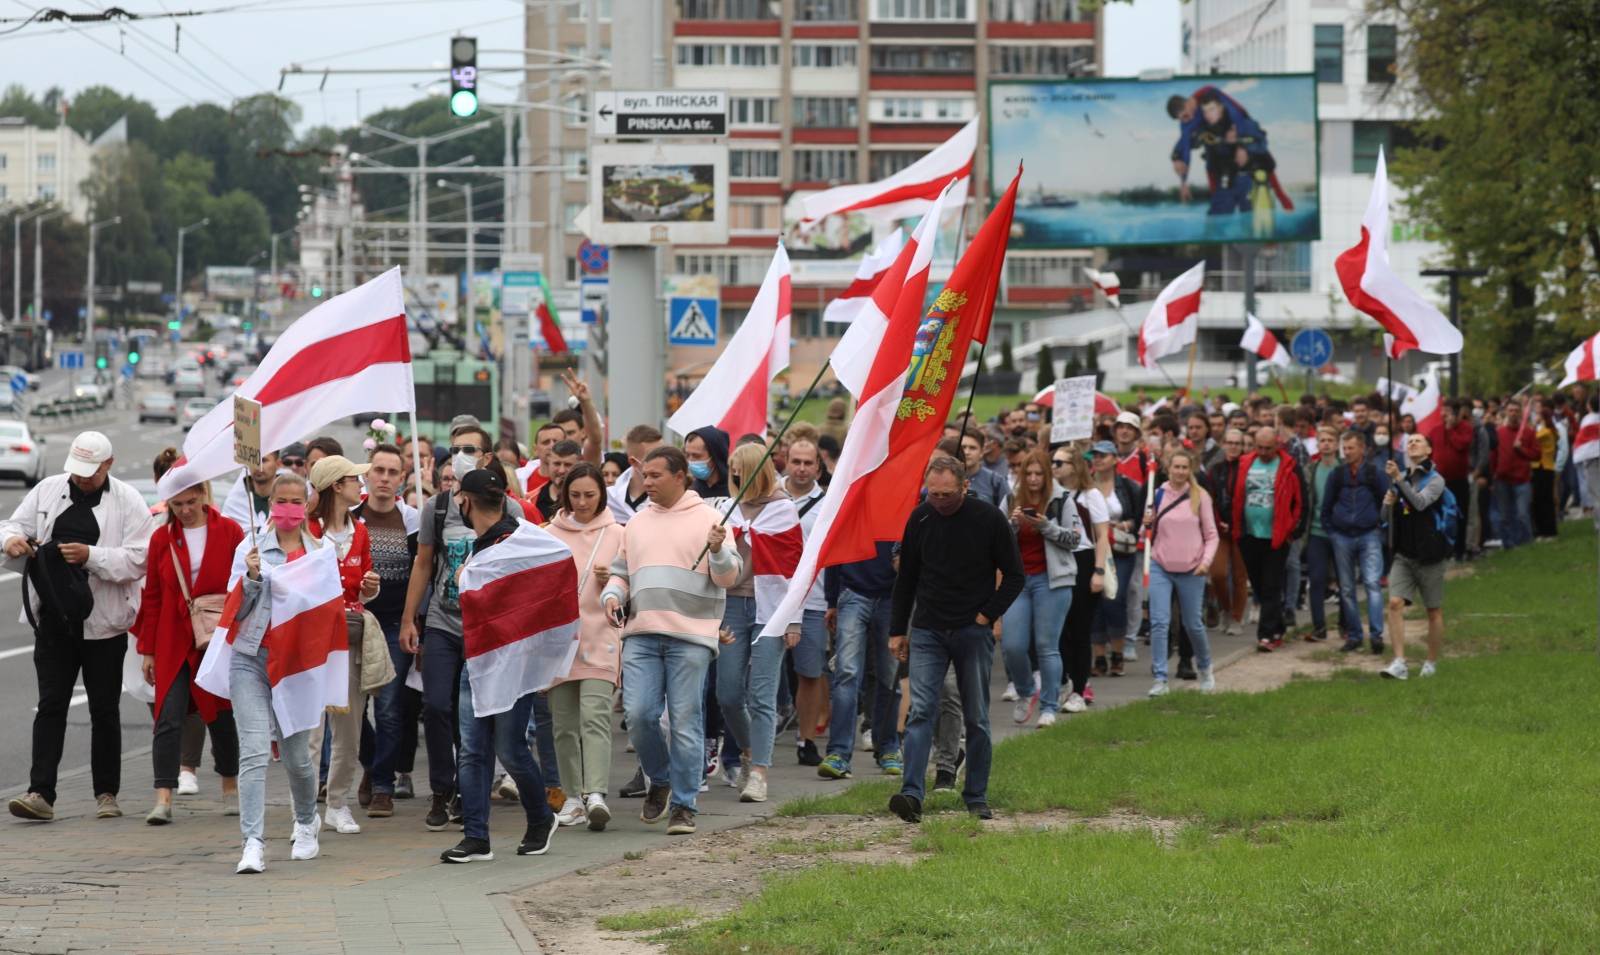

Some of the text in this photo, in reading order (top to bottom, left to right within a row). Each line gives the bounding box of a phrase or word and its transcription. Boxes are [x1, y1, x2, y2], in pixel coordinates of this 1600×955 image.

[624, 96, 718, 110] вул. ПІНСКАЯ
[628, 118, 714, 130] PINSKAJA str.
